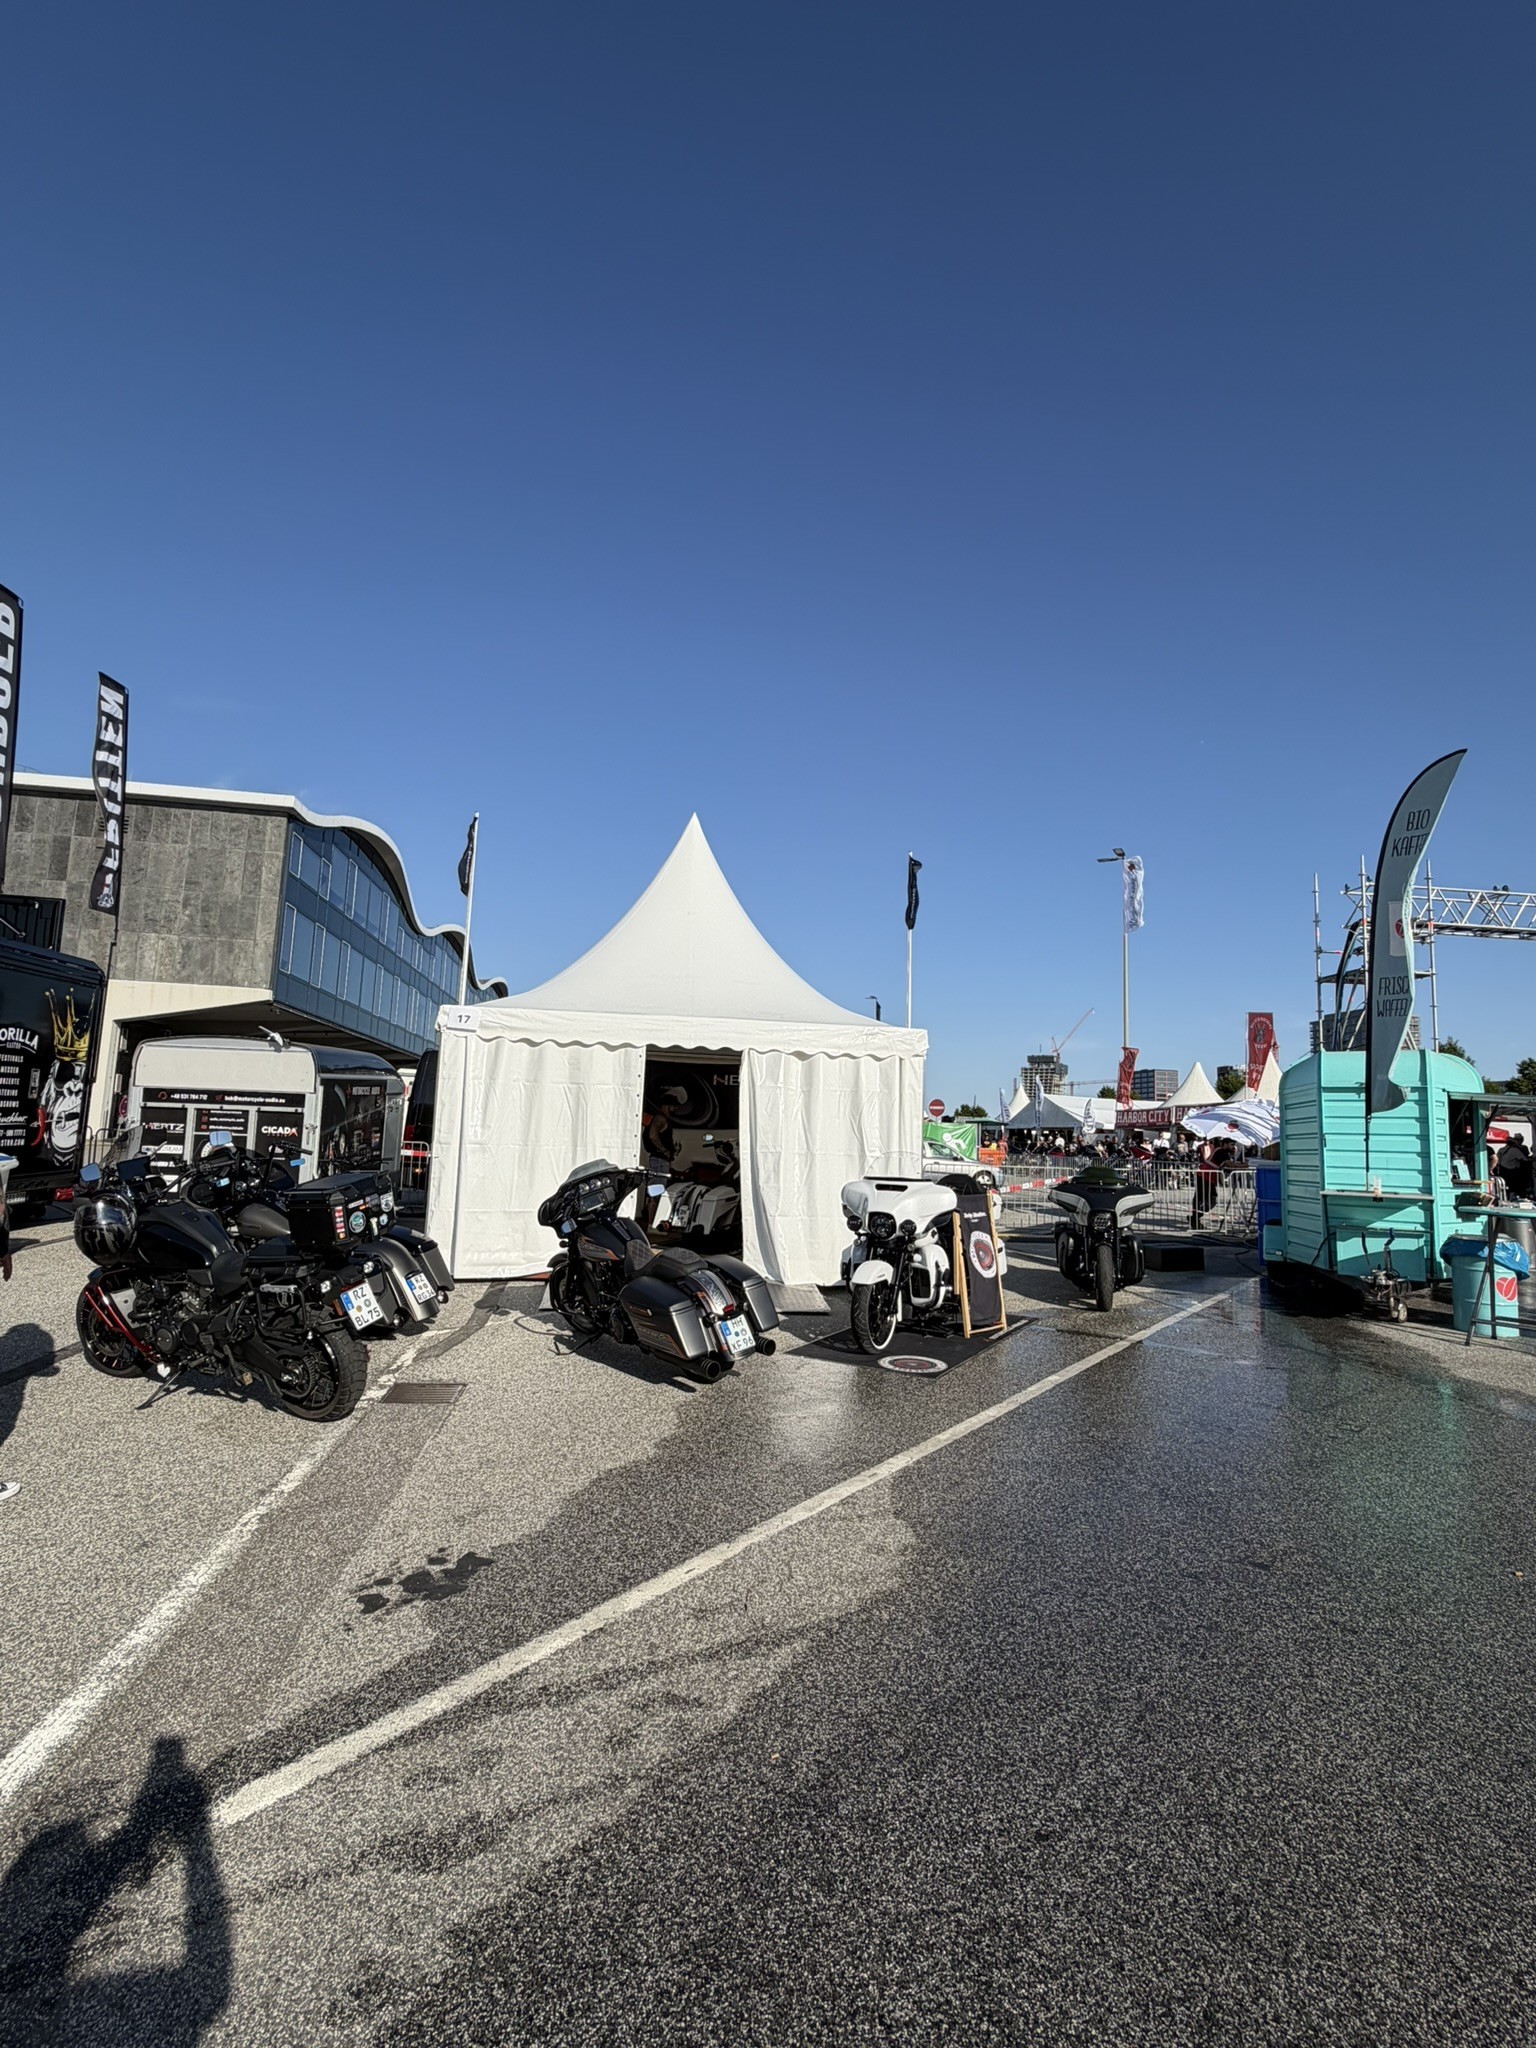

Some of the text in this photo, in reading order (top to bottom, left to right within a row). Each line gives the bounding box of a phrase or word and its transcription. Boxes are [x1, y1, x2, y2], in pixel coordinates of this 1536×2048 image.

[1406, 809, 1430, 831] BIO
[457, 1014, 471, 1024] 17
[0, 1027, 39, 1050] ORILLA
[1117, 1109, 1170, 1123] HARBOR CITY
[142, 1122, 185, 1132] HERTZ
[261, 1125, 299, 1137] CICADA
[352, 1286, 367, 1301] RZ
[354, 1306, 381, 1327] BL 75
[731, 1316, 744, 1329] HH
[731, 1340, 743, 1351] XF
